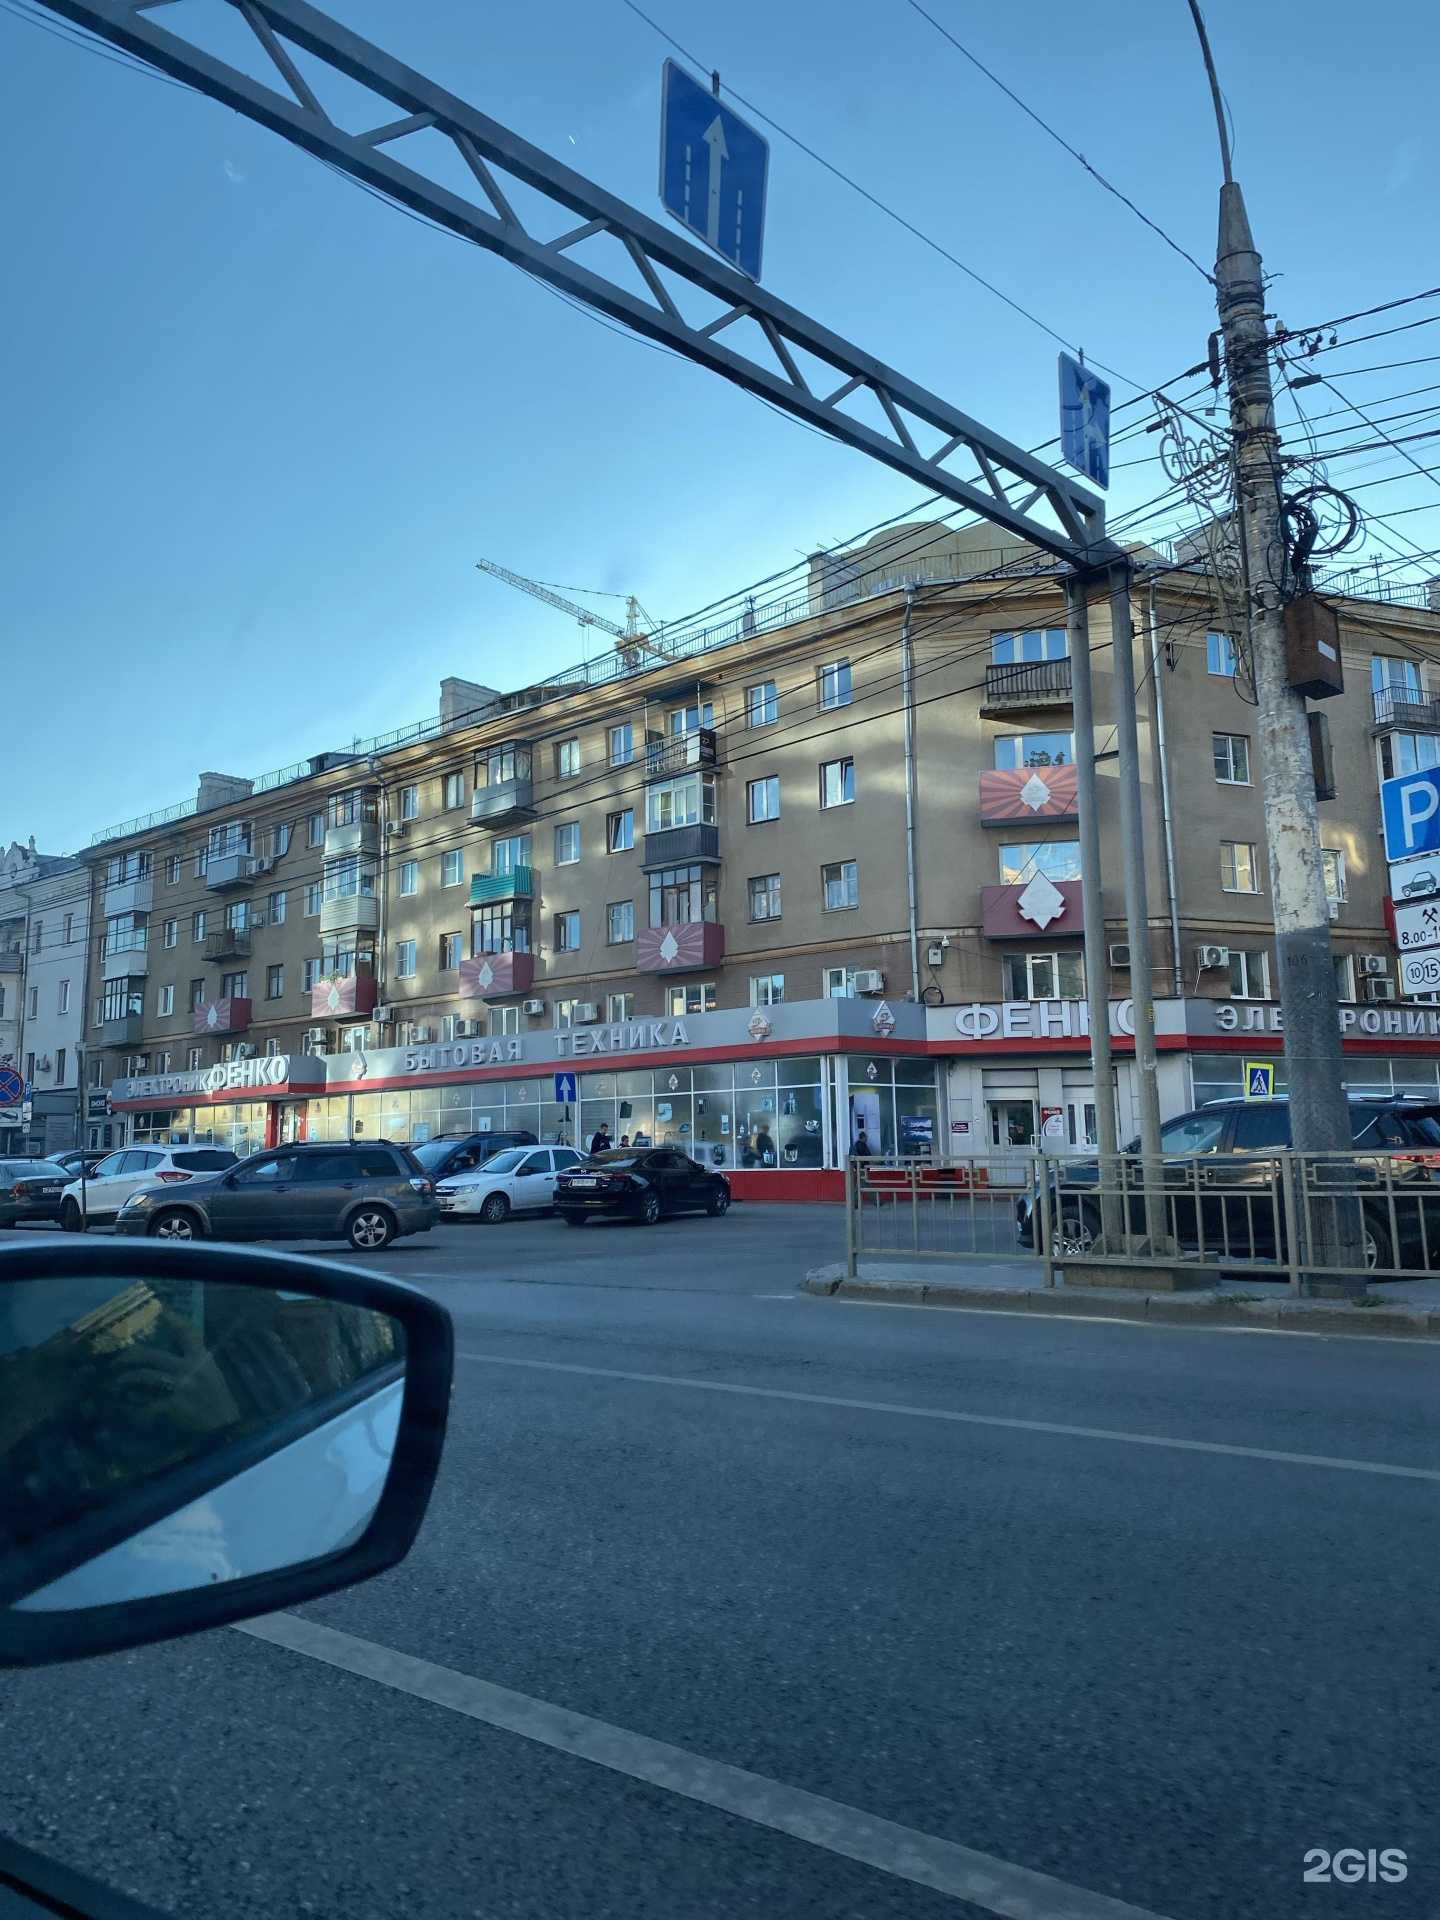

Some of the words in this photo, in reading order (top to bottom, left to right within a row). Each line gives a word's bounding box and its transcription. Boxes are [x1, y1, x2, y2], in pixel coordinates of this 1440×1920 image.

[1400, 780, 1439, 848] P
[1401, 925, 1440, 945] 8.00-1
[1410, 966, 1421, 978] 10
[1425, 963, 1439, 978] 15
[1215, 1005, 1440, 1036] ЭЛЕРОНИК
[405, 1039, 524, 1071] БЫТОВАЯ
[554, 1019, 690, 1056] ТЕХНИКА
[208, 1054, 290, 1090] ФЕНКО
